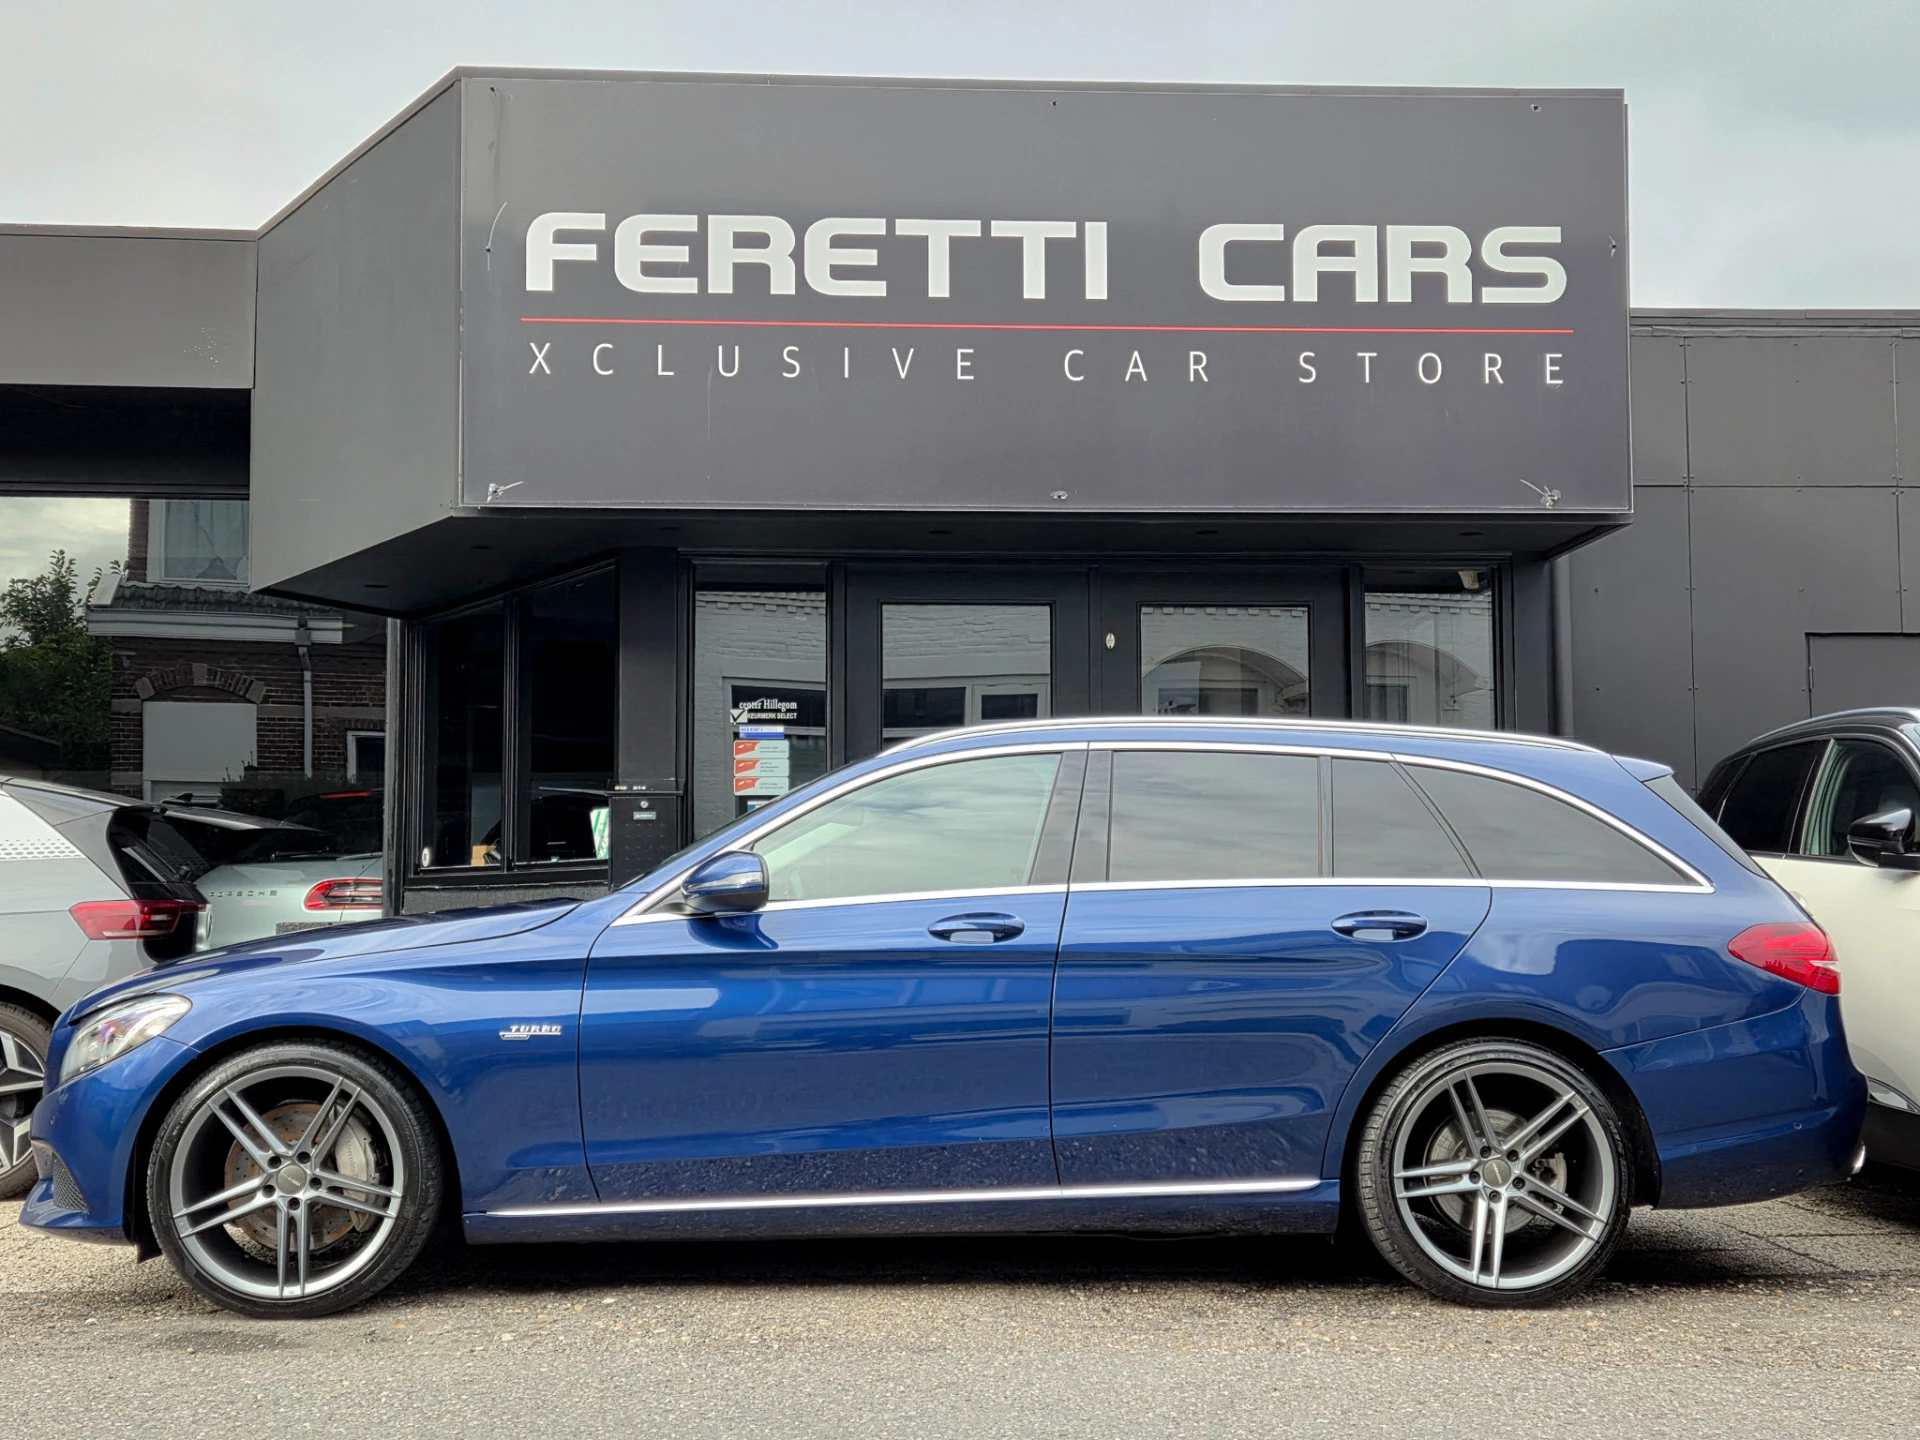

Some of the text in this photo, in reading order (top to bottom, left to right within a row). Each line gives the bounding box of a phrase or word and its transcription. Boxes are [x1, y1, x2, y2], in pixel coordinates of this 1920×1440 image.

[525, 212, 1568, 304] FERETTI CARS
[528, 342, 1565, 385] XCLUSIVE CAR STORE
[747, 712, 798, 720] KEURMERK SELECT
[763, 699, 797, 712] Hillegom
